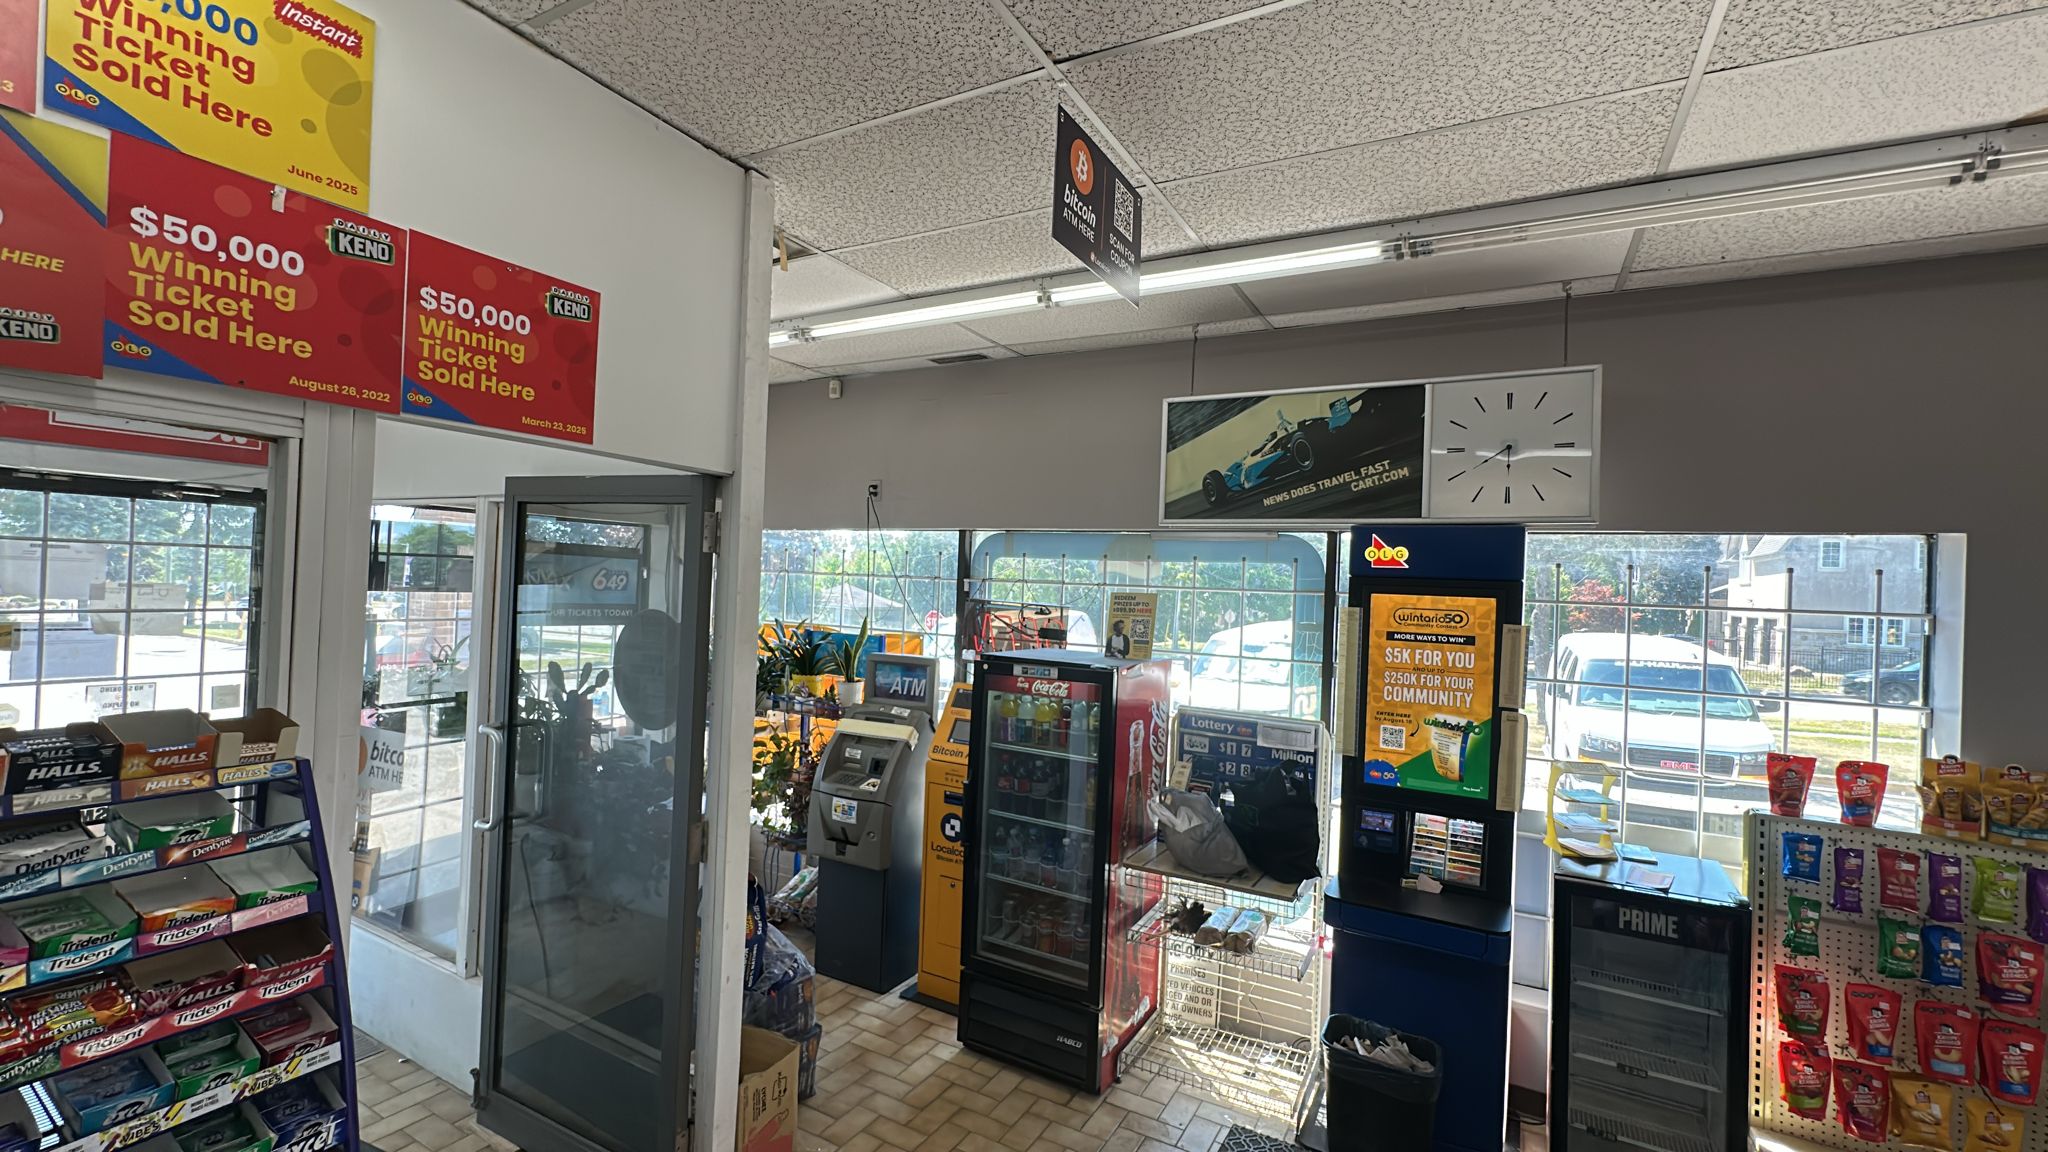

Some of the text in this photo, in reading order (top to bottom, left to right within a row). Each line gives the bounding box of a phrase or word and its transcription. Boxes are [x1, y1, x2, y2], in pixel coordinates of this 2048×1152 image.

[280, 3, 360, 47] Instant
[74, 10, 210, 88] Ticket
[79, 0, 256, 85] Winning
[56, 83, 100, 105] OLG
[72, 43, 273, 137] Sold Here
[287, 165, 358, 196] June 2025
[1064, 183, 1097, 228] bitcoin
[334, 218, 391, 241] DAILY
[1062, 207, 1095, 243] ATM HERE
[130, 205, 305, 276] $50,000
[338, 232, 390, 262] KENO
[1109, 233, 1136, 265] SCAN FOR
[1110, 249, 1133, 277] COUPON
[129, 241, 296, 312] Winning
[128, 270, 254, 321] Ticket
[551, 286, 590, 304] DAILY
[419, 285, 531, 335] $50,000
[553, 297, 589, 319] KENO
[128, 300, 313, 358] Sold Here
[419, 314, 525, 364] Winning
[112, 341, 151, 356] OLG
[418, 337, 498, 373] Ticket
[289, 376, 391, 403] August 26, 2022
[418, 360, 536, 401] Sold Here
[522, 416, 587, 435] March 23, 2025
[1263, 459, 1391, 507] NEWS DOES TRAVEL FAST
[1351, 466, 1410, 492] CART.COM
[1367, 548, 1406, 561] OLG
[568, 608, 602, 617] TICKETS
[604, 608, 633, 617] TODAY!
[1398, 613, 1464, 625] wintario50
[1394, 633, 1415, 641] MORE
[1416, 634, 1436, 642] WAYS
[1385, 646, 1475, 669] $5K FOR YOU
[889, 677, 927, 697] ATM
[1031, 679, 1070, 697] Coca-Cola
[1384, 671, 1474, 690] $250K FOR YOUR
[1383, 685, 1473, 708] COMMUNITY
[1191, 716, 1235, 734] Lottery
[154, 751, 208, 768] HALLS
[932, 745, 964, 758] Bitcoin
[1271, 749, 1314, 765] Million
[28, 761, 101, 780] HALLS
[223, 768, 262, 782] HALLS
[368, 765, 389, 781] ATM
[1660, 760, 1699, 772] GMC
[145, 777, 191, 792] HALLS
[192, 836, 233, 858] Dentyne
[15, 844, 91, 875] Dentyne
[102, 849, 155, 876] Dentyne
[167, 910, 217, 929] Trident
[1618, 907, 1679, 940] PRIME
[60, 931, 118, 952] Trident
[155, 923, 213, 945] Trident
[48, 947, 115, 971] Trident
[177, 981, 236, 1006] HALLS
[261, 974, 311, 998] Trident
[1181, 981, 1215, 996] VEHICLES
[176, 999, 232, 1025] Trident
[1181, 1004, 1213, 1018] OWNERS
[1184, 994, 1212, 1007] AND OR
[80, 1027, 144, 1056] Trident
